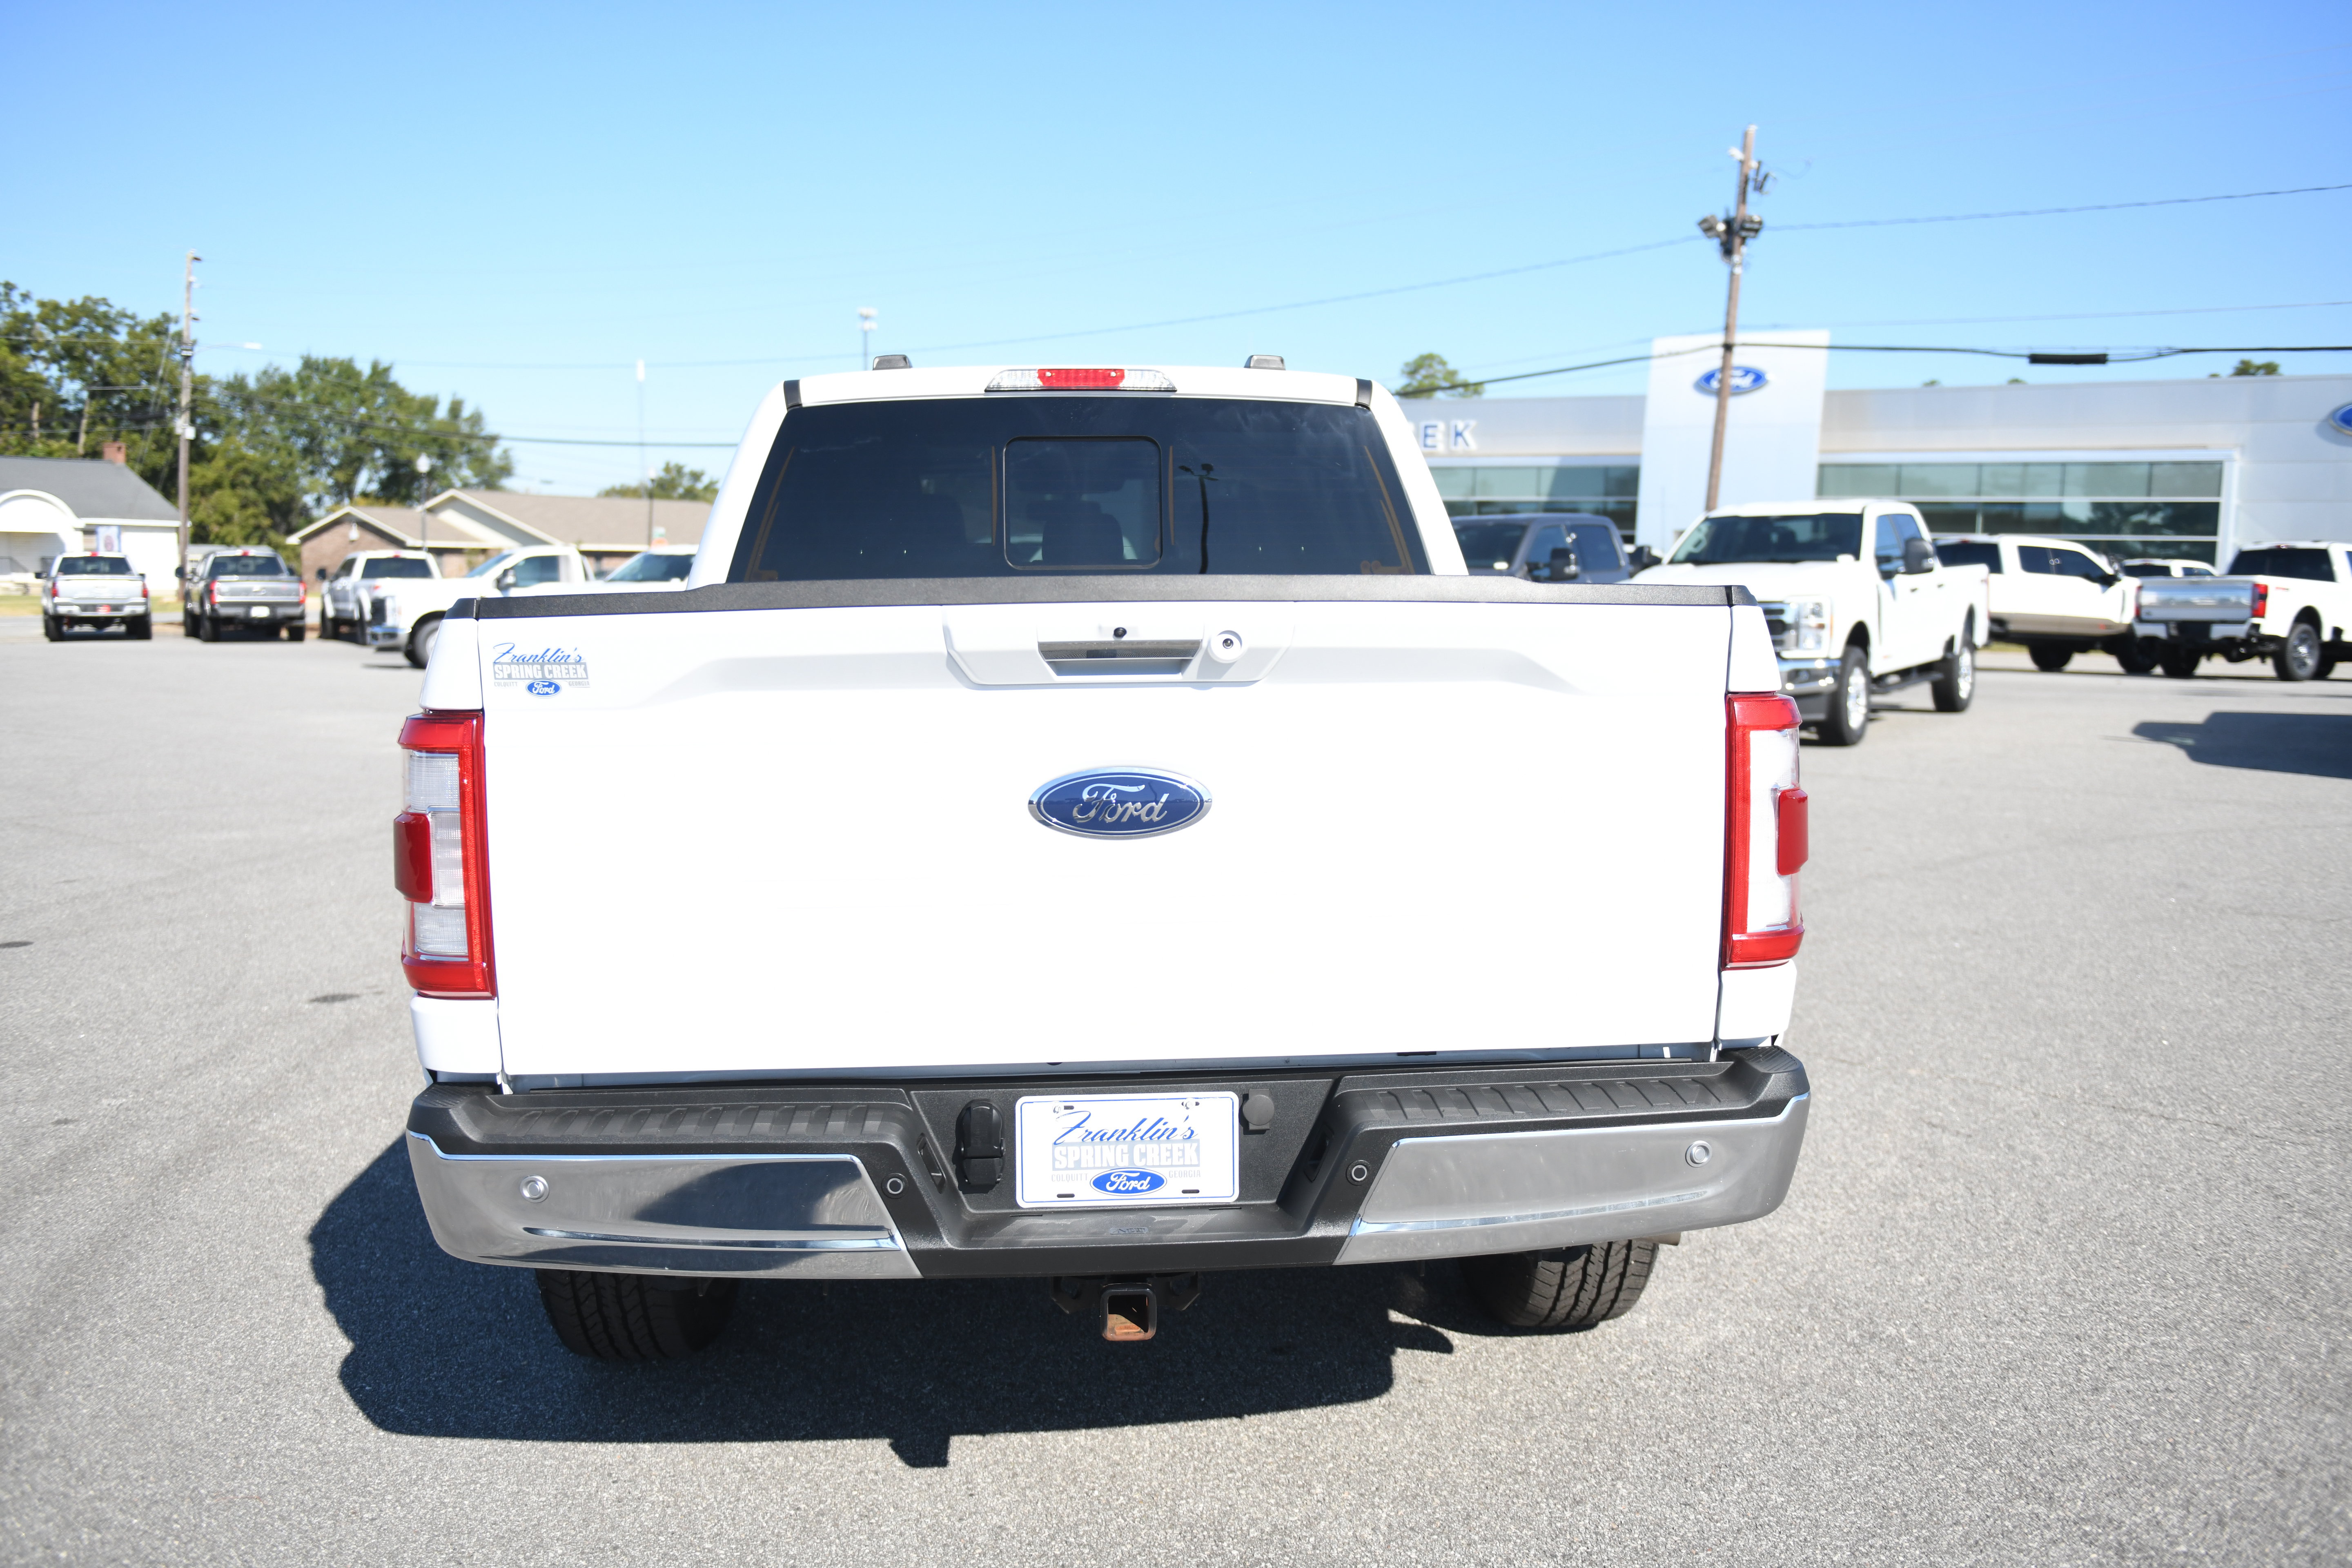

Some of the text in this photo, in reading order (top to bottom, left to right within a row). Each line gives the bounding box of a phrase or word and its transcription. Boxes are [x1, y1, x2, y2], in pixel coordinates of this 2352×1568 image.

[1710, 370, 1755, 388] Frd
[1409, 419, 1477, 452] EK
[493, 642, 584, 664] Franklin's
[494, 664, 587, 679] SPRING CREEK
[532, 681, 555, 694] Ford
[1072, 783, 1169, 823] Ford
[1054, 1111, 1199, 1145] Franklin's
[1054, 1143, 1199, 1169] SPRING CREEK
[1051, 1173, 1088, 1182] COLQUITT
[1106, 1172, 1151, 1191] Ford
[1169, 1169, 1201, 1178] GEORGIA
